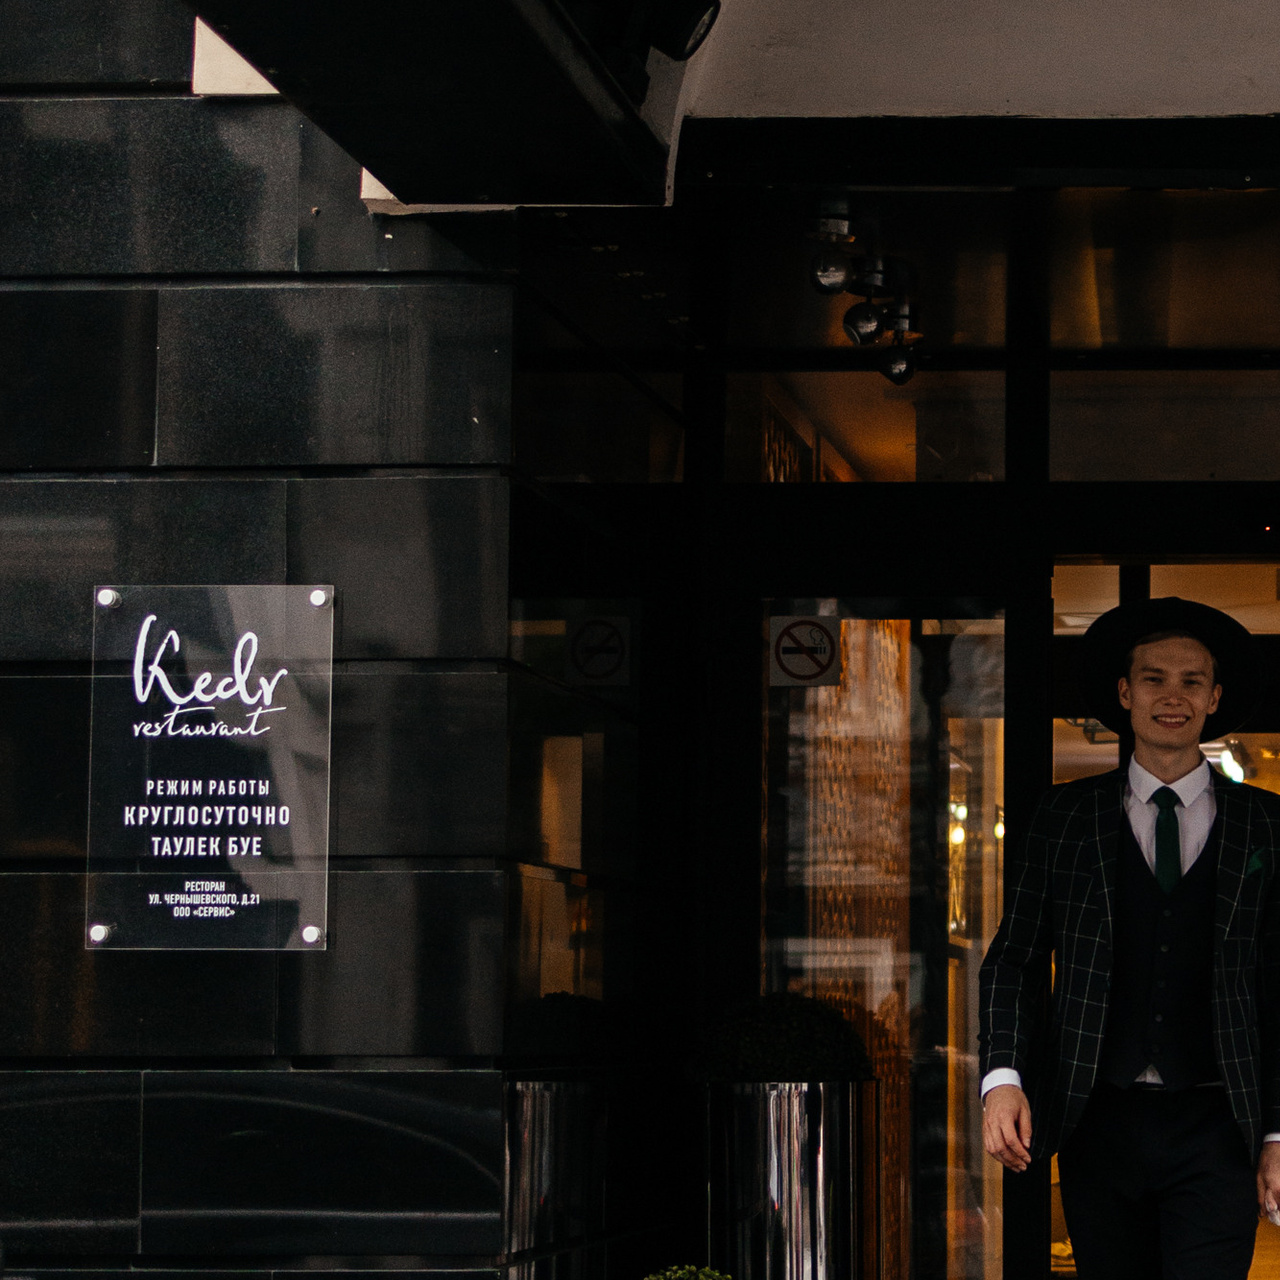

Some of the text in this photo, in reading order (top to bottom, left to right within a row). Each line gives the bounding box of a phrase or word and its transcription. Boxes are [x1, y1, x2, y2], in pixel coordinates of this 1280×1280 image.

[133, 614, 288, 706] Kedr
[133, 705, 287, 737] restaurant
[146, 779, 270, 796] РЕЖИМ РАБОТЫ
[124, 805, 290, 826] КРУГЛОСУТОЧНО
[151, 836, 262, 856] ТАУЛЕК БУЕ
[185, 881, 226, 892] РЕСТОРАН
[149, 893, 260, 906] УЛ. ЧЕРНЫШЕВСКОГО, Д.21
[193, 906, 236, 917] «СЕРВИС»
